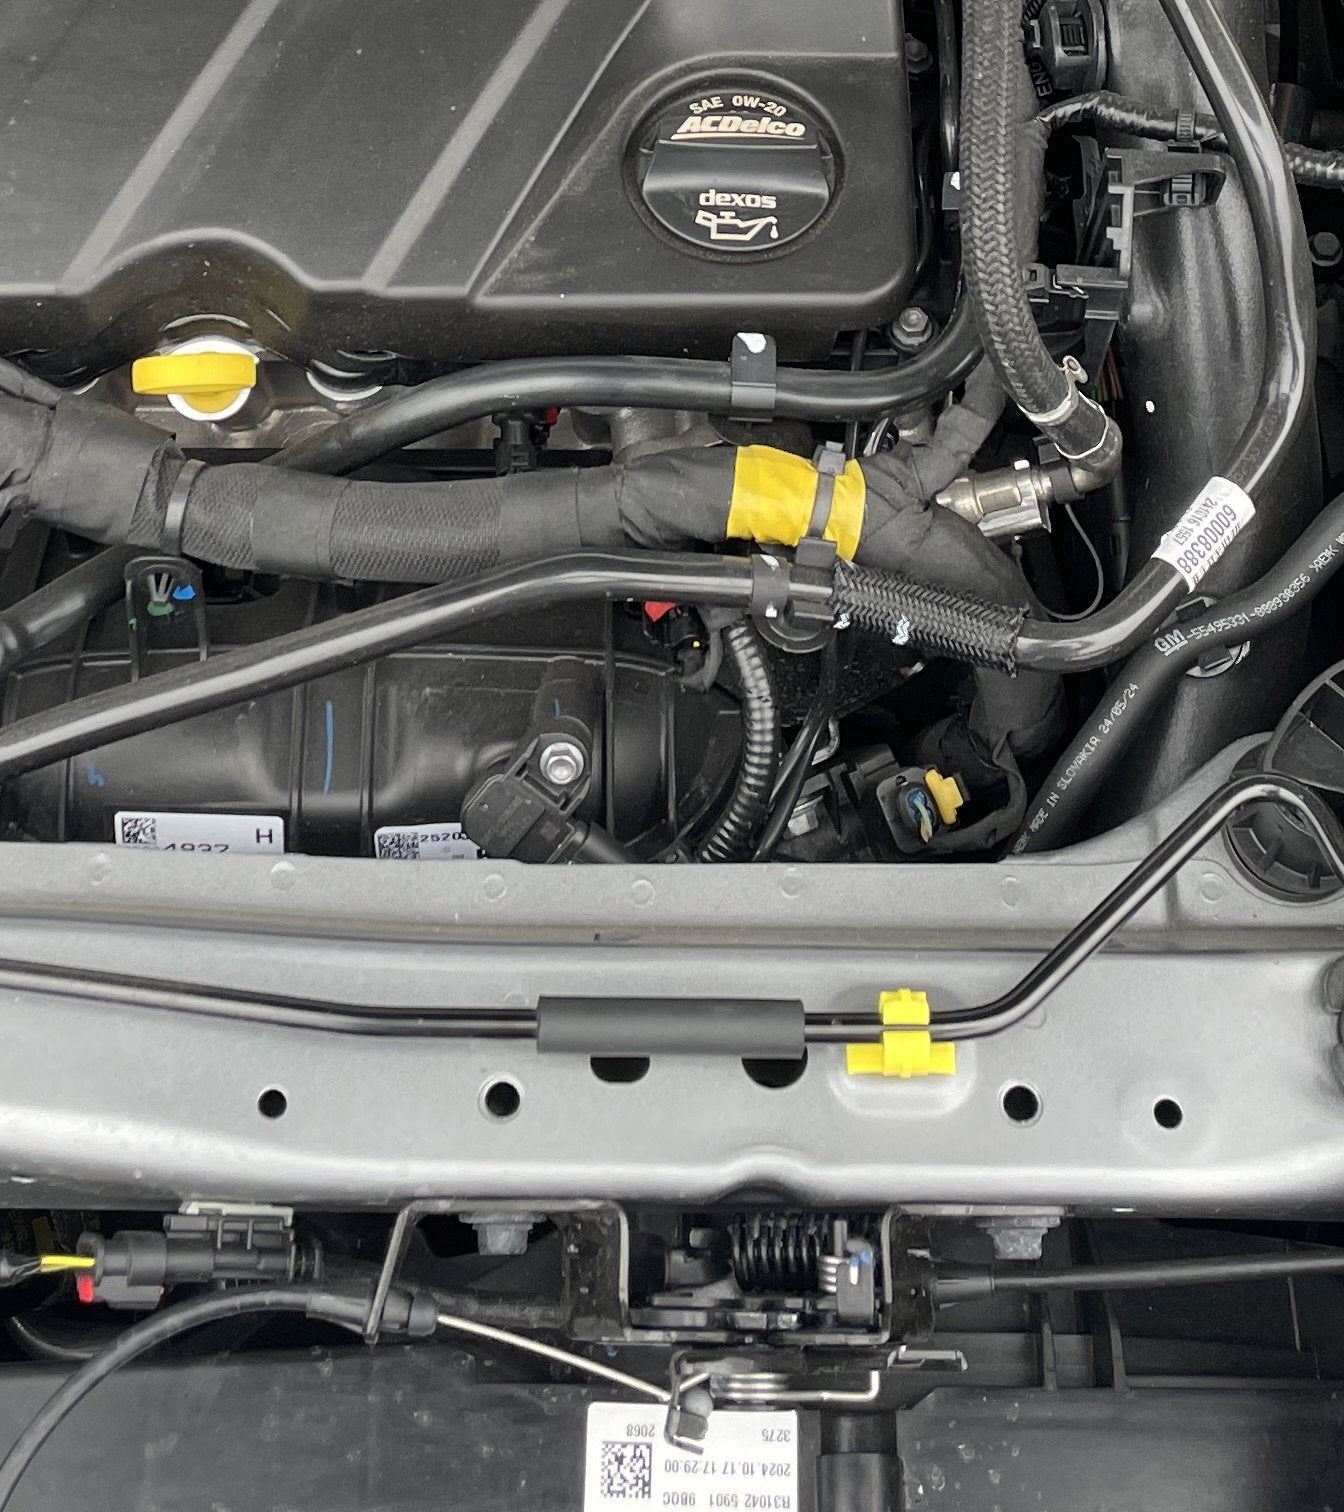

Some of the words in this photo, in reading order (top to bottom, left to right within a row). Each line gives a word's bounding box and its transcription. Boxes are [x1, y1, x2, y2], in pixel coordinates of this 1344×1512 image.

[689, 95, 724, 115] SAE
[732, 95, 786, 117] 0W-20
[676, 116, 806, 137] ACDelco
[699, 189, 777, 209] dexos
[1177, 504, 1237, 574] 60008388
[1154, 629, 1188, 654] GM
[1046, 791, 1061, 808] IN
[1056, 734, 1101, 791] SLOVAKIA
[256, 828, 273, 844] H
[626, 1423, 655, 1437] 2068
[761, 1428, 791, 1442] 3275
